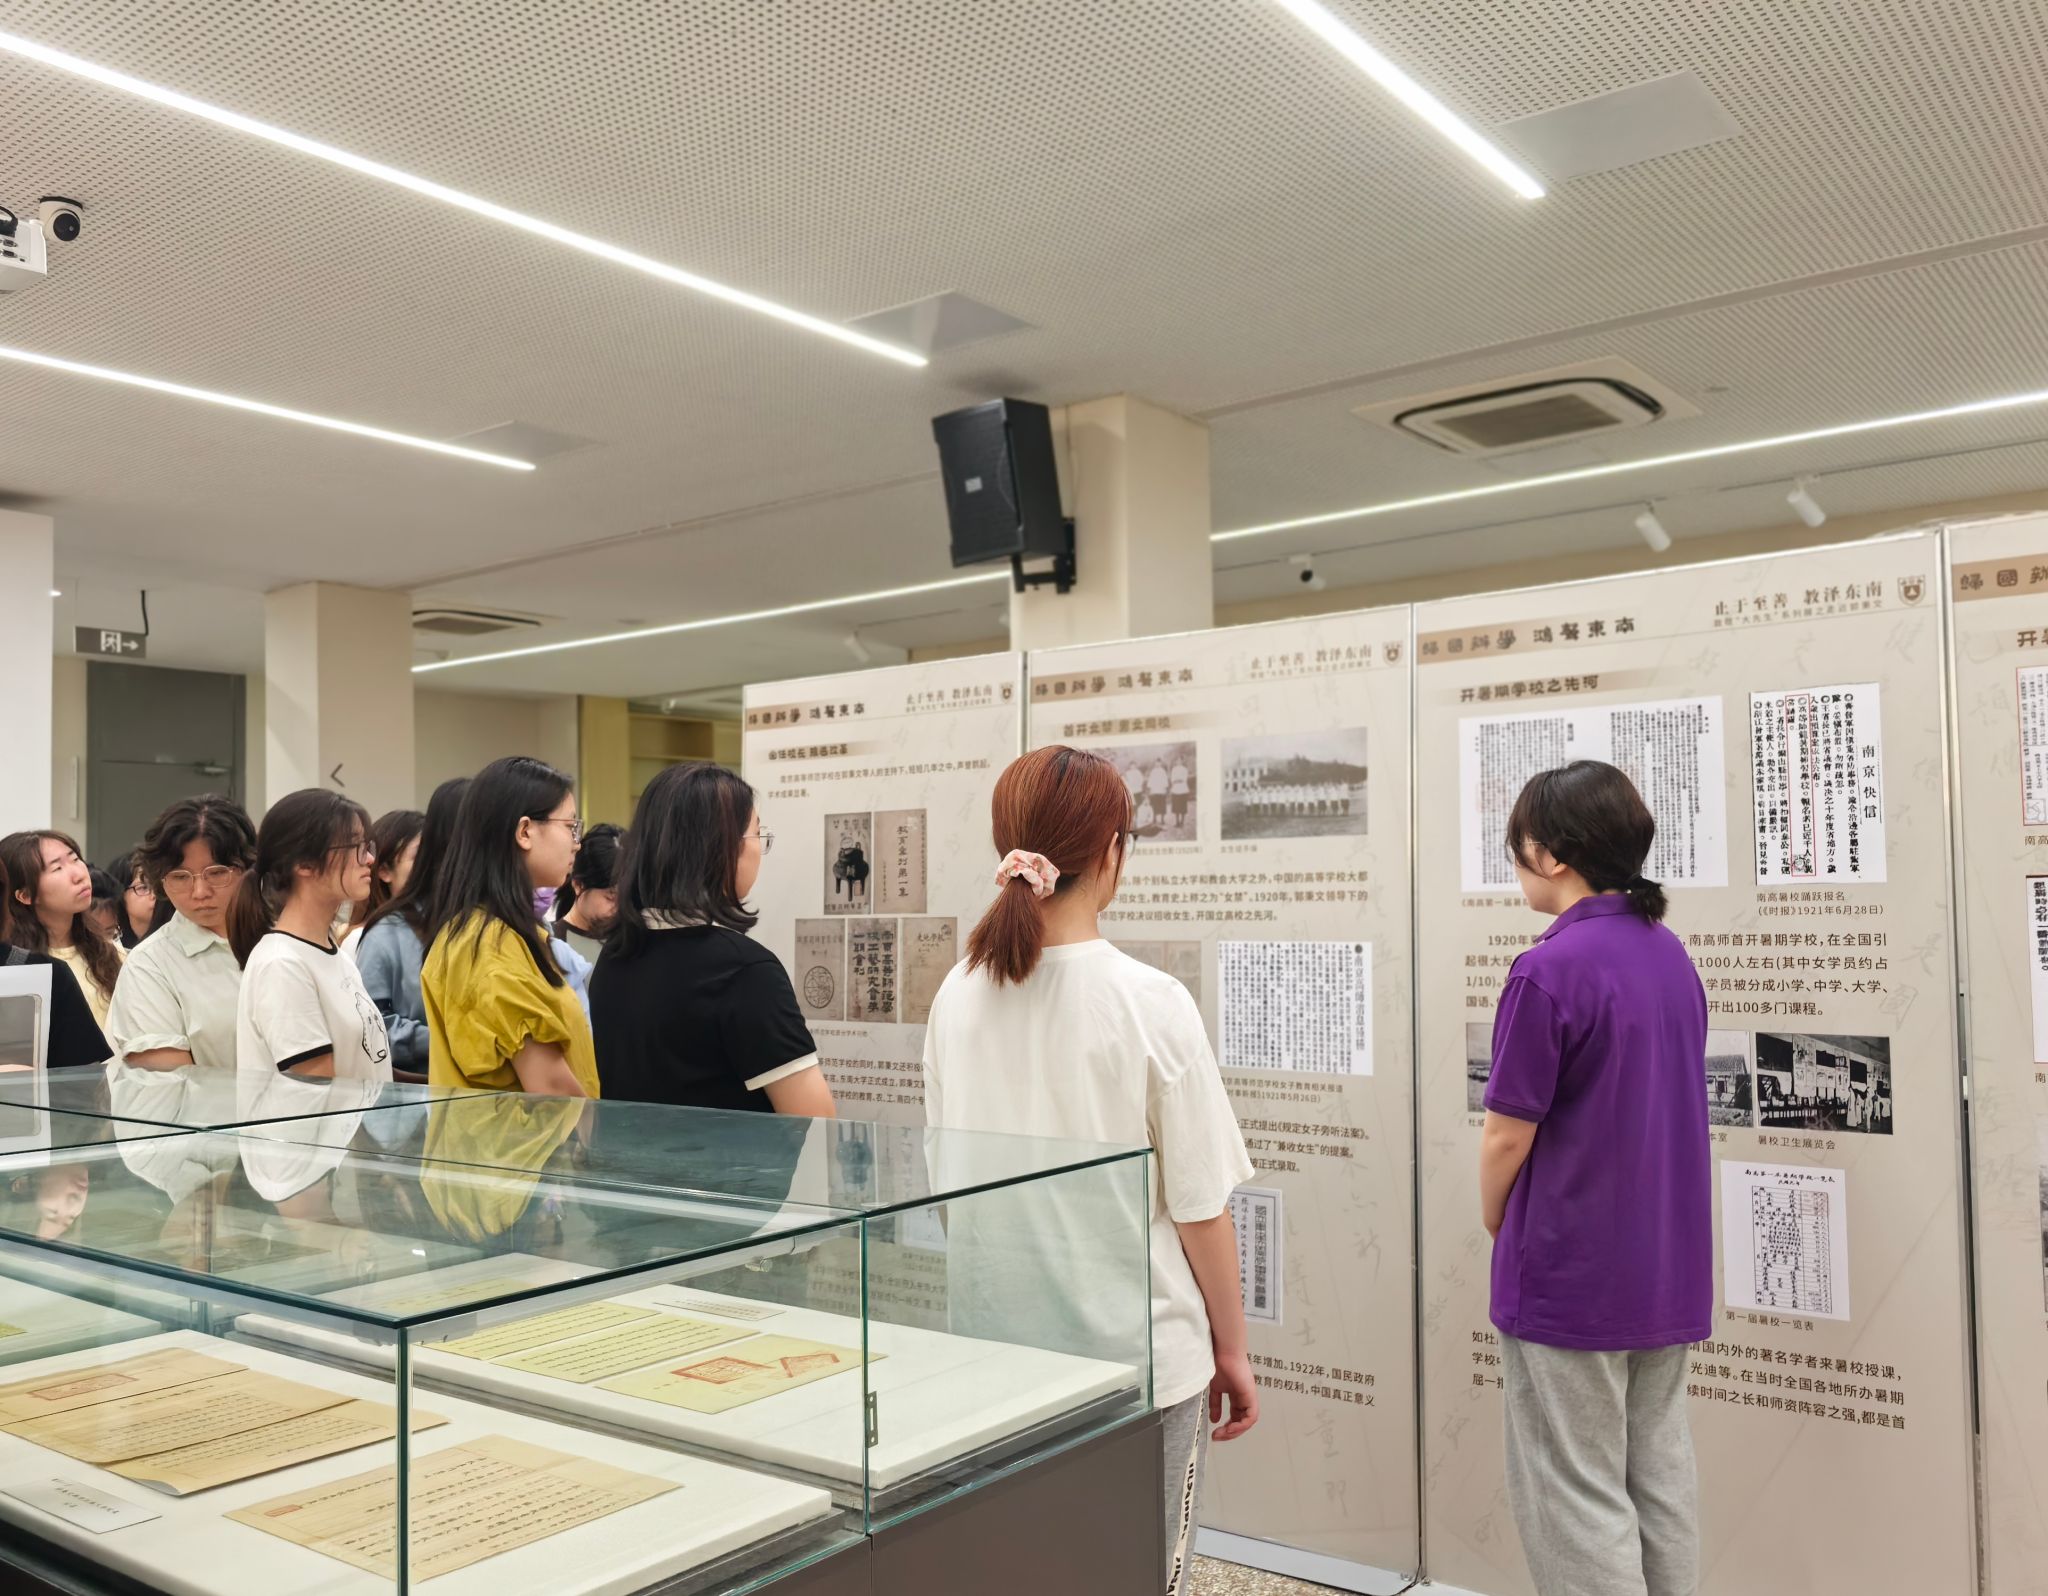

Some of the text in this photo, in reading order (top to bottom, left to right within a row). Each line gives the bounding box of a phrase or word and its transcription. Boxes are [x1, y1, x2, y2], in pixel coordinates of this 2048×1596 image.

[1714, 580, 1883, 616] 止于至善 教泽东南
[1861, 744, 1878, 819] 南京快信
[1756, 891, 1845, 903] 南高暑校踊跃报名
[1705, 977, 1889, 994] 学员被分成小学、中学、大学、
[1708, 1001, 1824, 1016] 开出100多门课程。
[1758, 1134, 1836, 1150] 暑校卫生展览会
[1725, 1310, 1814, 1332] 第一届暑校一览表
[1471, 1329, 1499, 1345] 如杜
[1690, 1361, 1905, 1407] 光迪等。在当时全国各地所办暑期
[1686, 1383, 1906, 1431] 续时间之长和师资阵容之强，都是首
